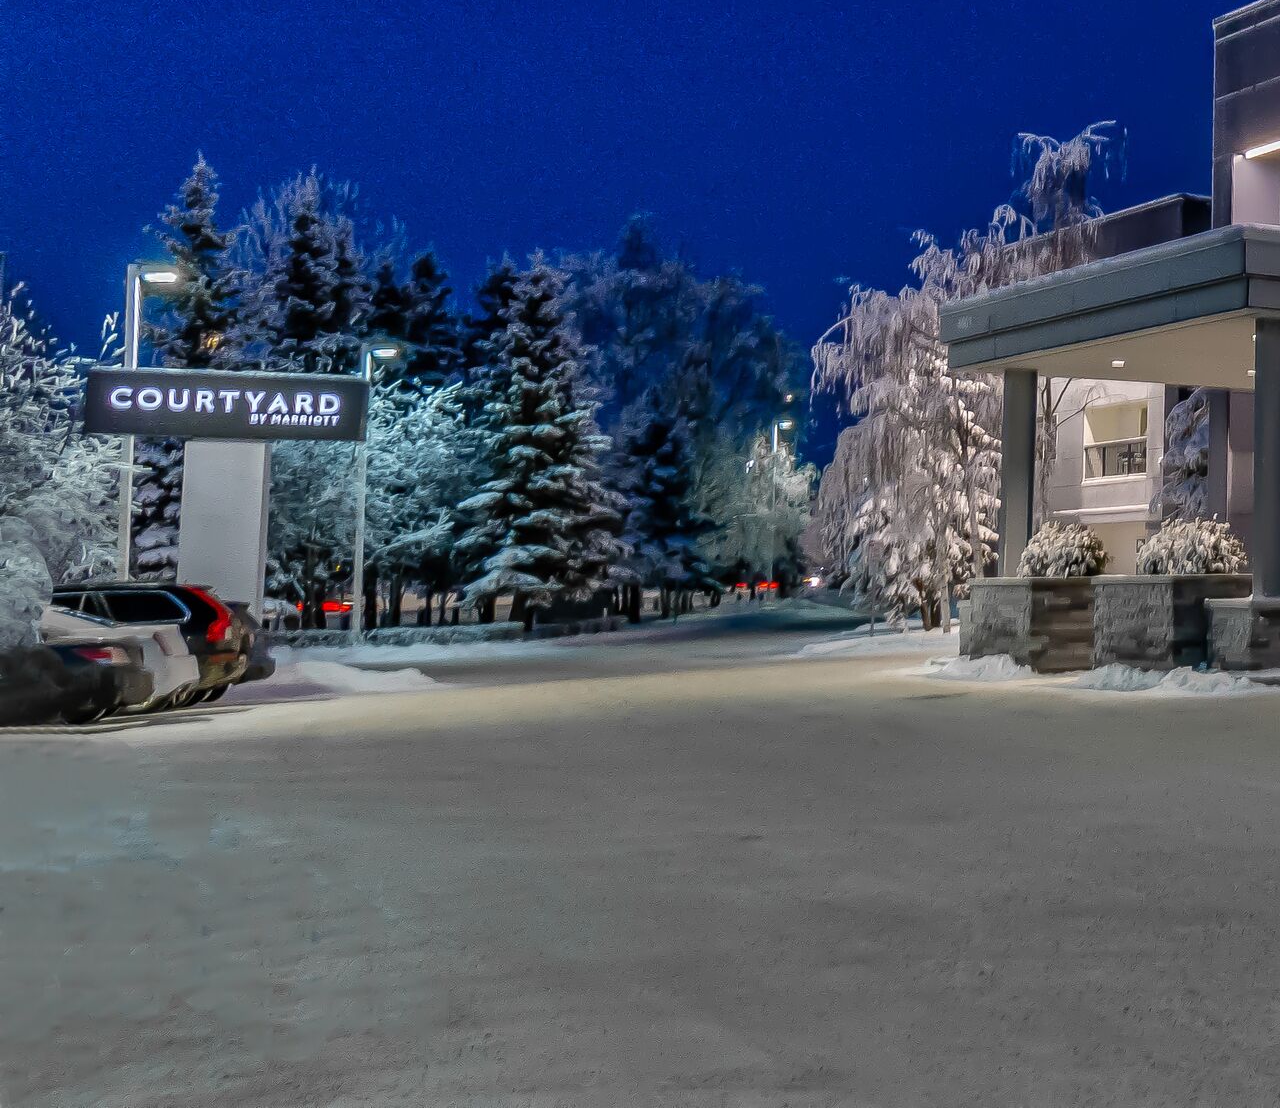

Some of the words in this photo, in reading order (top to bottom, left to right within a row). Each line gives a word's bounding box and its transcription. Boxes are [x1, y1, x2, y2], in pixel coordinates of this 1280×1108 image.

[108, 386, 342, 415] COURTYARD
[249, 413, 268, 426] BY
[270, 413, 341, 427] MARRIOTT
